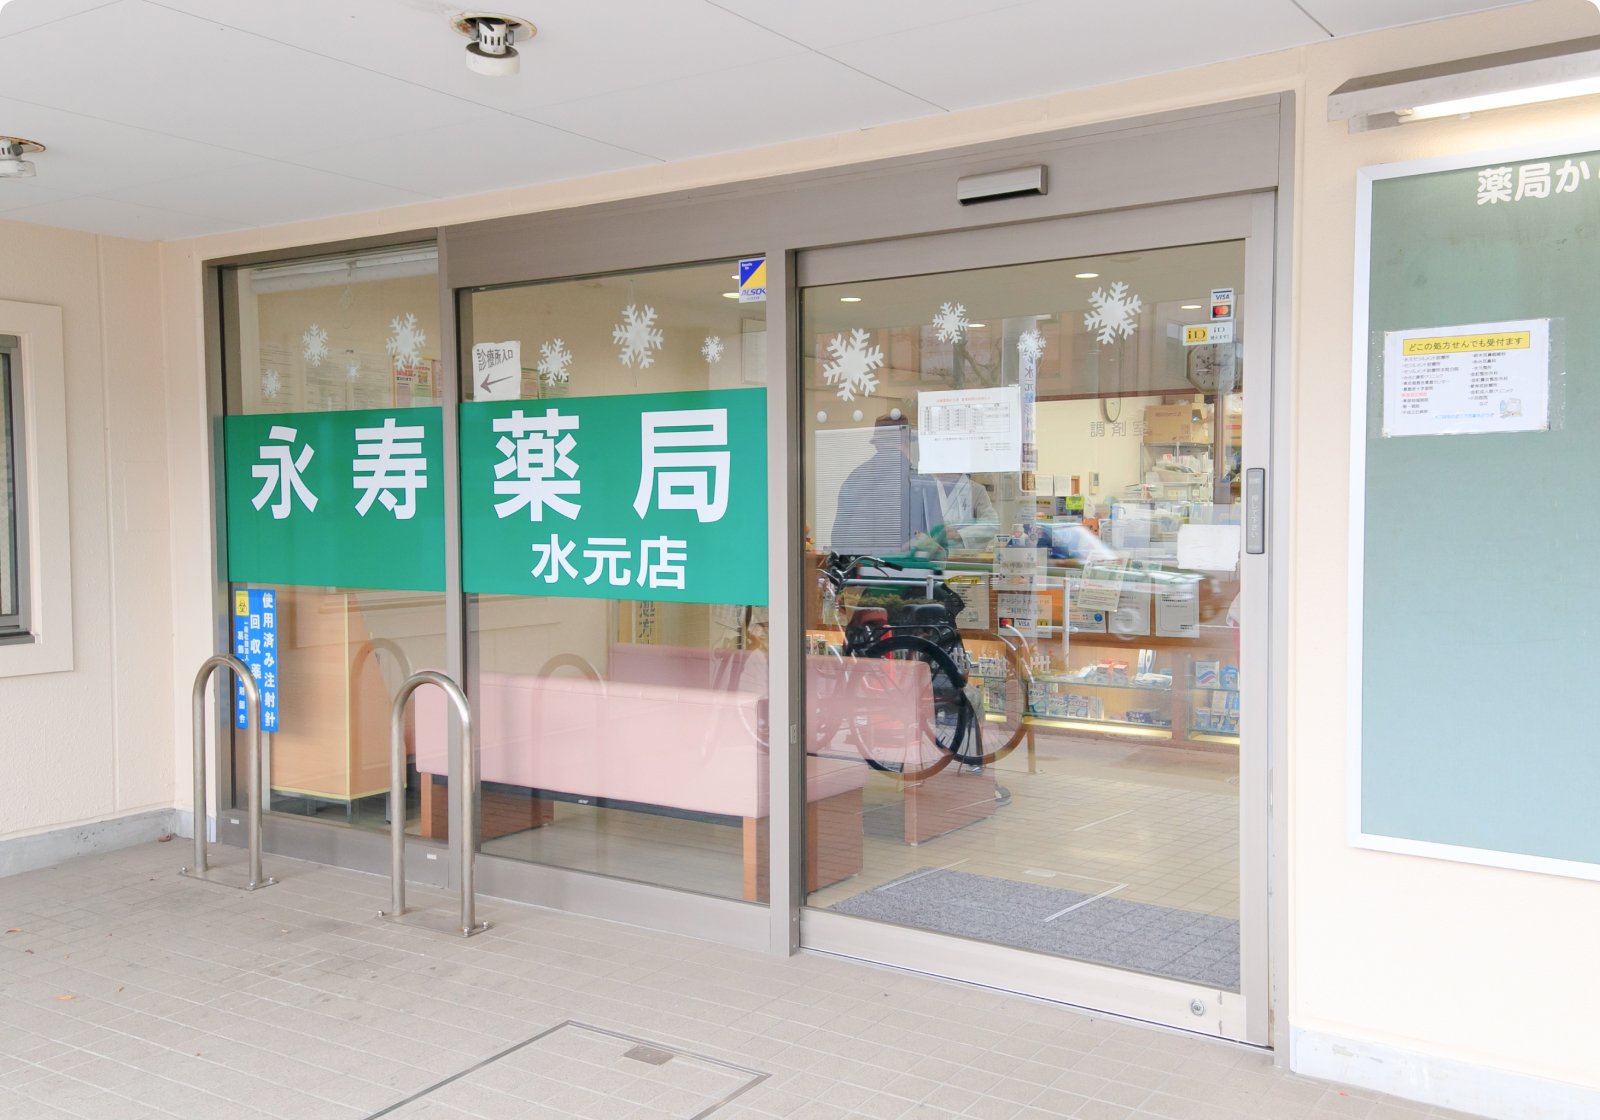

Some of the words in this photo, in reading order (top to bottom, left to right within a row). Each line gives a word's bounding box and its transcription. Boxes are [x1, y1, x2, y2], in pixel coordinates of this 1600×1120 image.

[1477, 160, 1600, 206] 薬局か
[742, 287, 766, 296] ALSOK
[476, 348, 514, 373] 診療所入口
[1409, 337, 1522, 352] どこの処方せんでも受付ます
[1090, 421, 1152, 438] 調剤室
[251, 408, 731, 523] 永寿薬局
[531, 533, 688, 590] 水元店
[250, 614, 262, 702] 回収薬
[262, 592, 276, 727] 使用済み注射針
